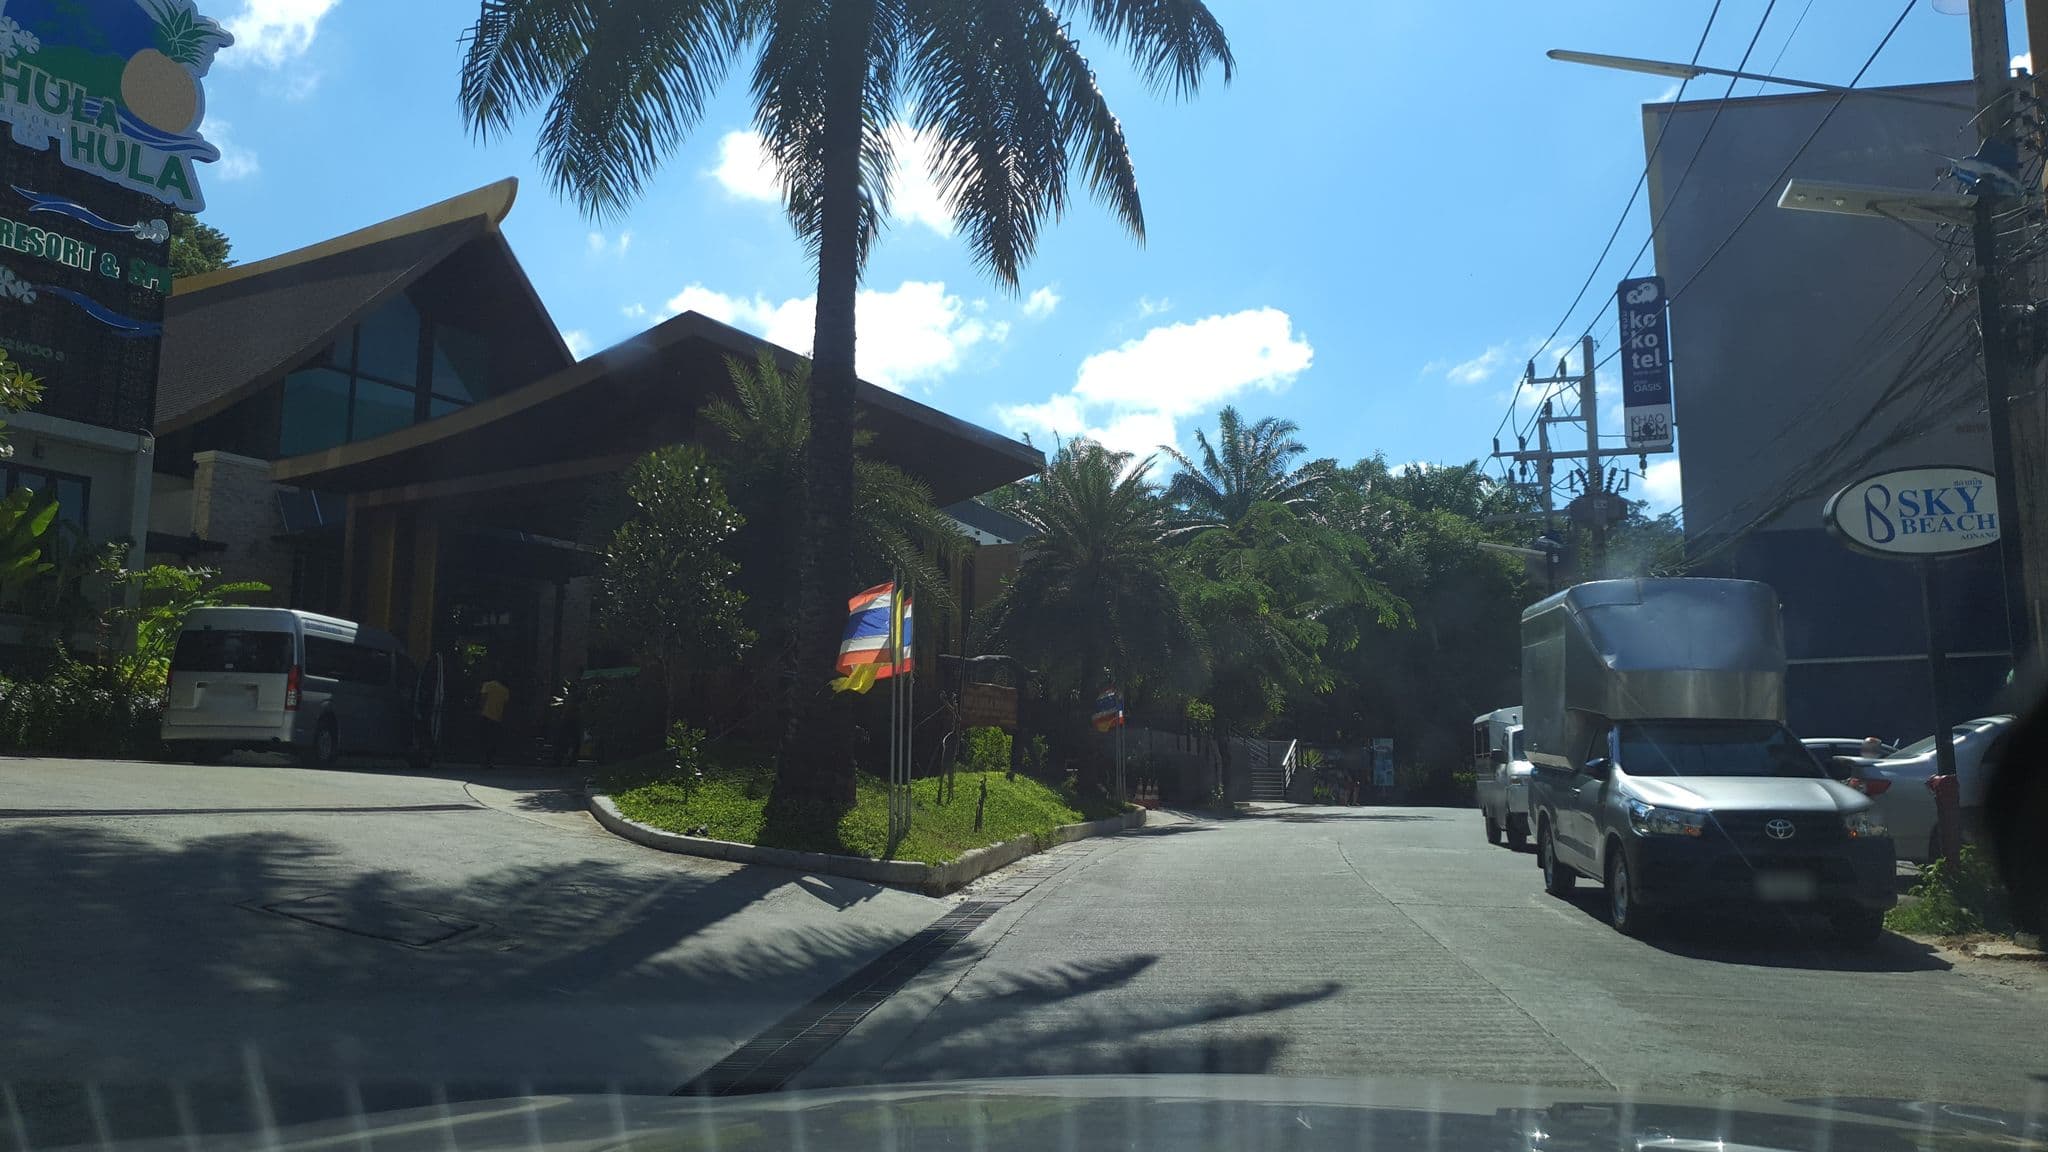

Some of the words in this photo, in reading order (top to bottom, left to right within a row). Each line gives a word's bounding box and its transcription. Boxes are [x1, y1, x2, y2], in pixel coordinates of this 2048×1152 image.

[0, 54, 120, 134] HULA
[70, 126, 194, 201] HULA
[0, 217, 96, 272] RESORT
[100, 252, 120, 279] &
[1631, 310, 1657, 329] ko
[1631, 331, 1658, 349] ko
[1631, 348, 1662, 369] tel
[1634, 383, 1662, 392] OASIS
[1631, 413, 1665, 425] KHAO
[1898, 486, 1983, 517] SKY
[1901, 513, 1996, 534] BEACH
[1961, 532, 1998, 541] AONANG
